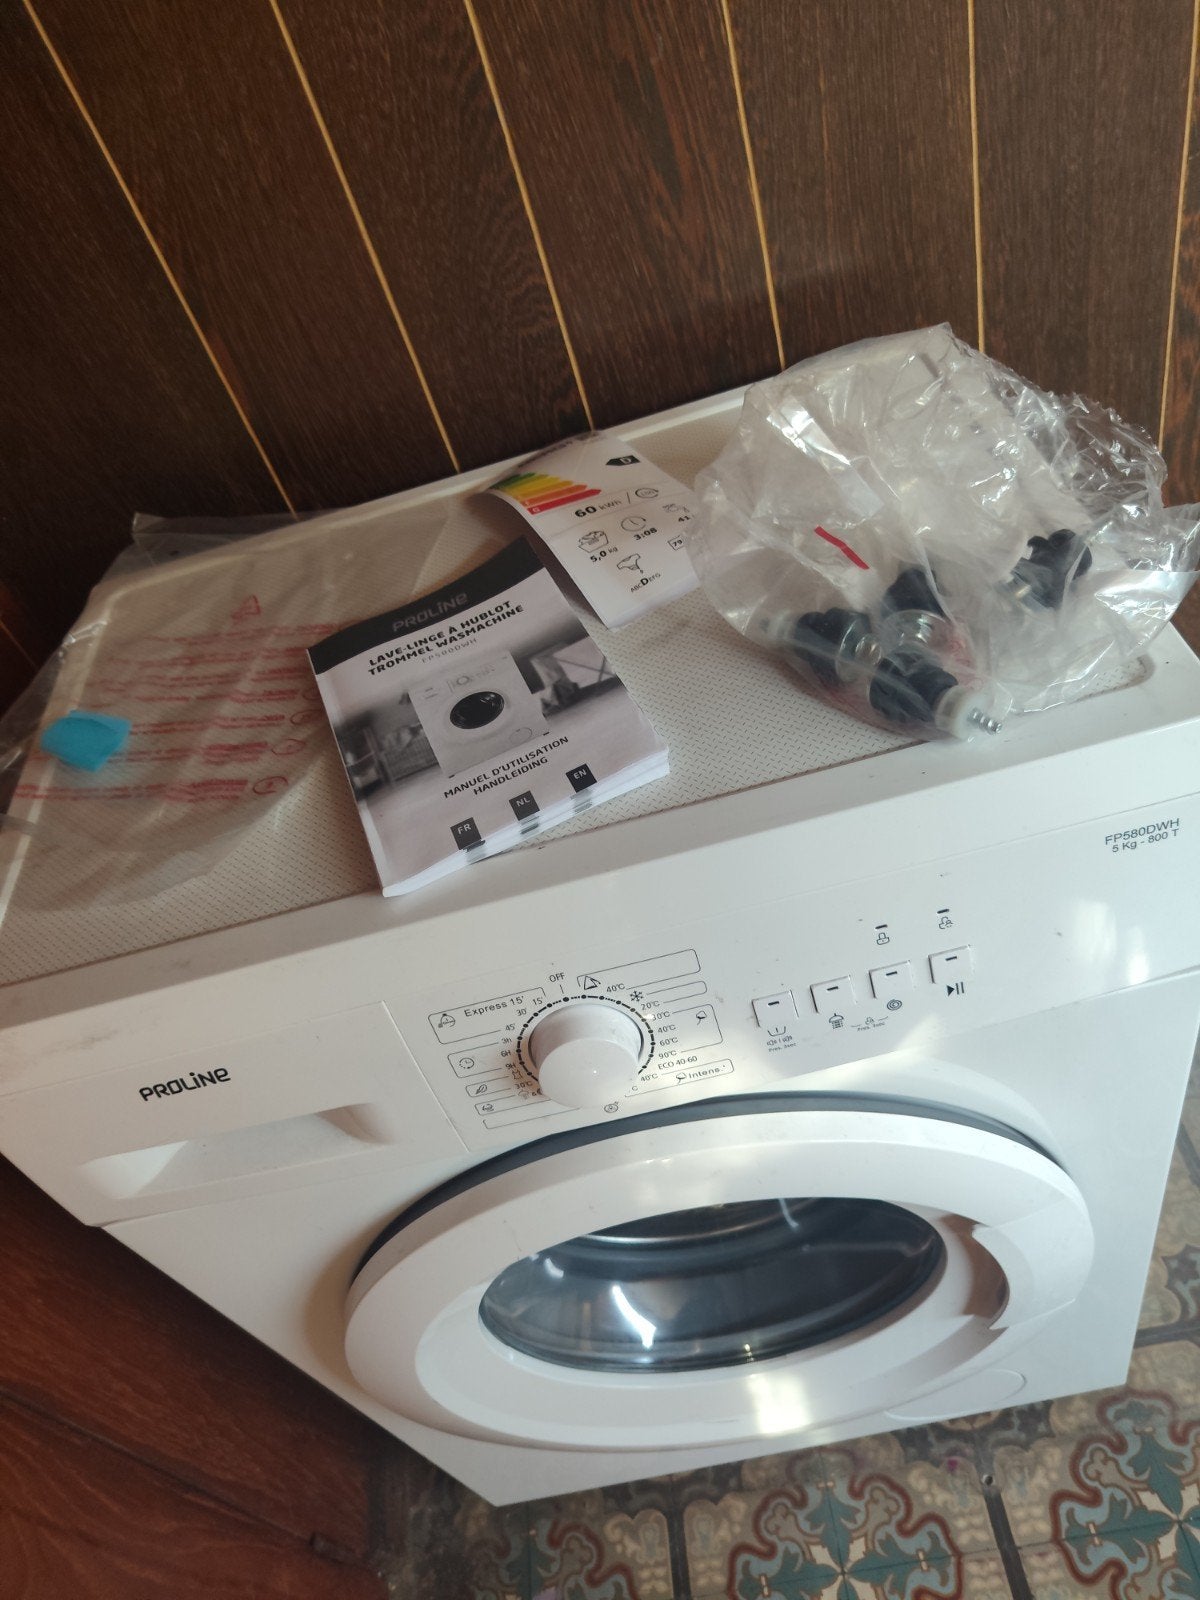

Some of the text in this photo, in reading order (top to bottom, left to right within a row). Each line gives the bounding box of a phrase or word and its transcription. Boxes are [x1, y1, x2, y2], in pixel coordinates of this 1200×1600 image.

[574, 505, 597, 518] 60
[599, 499, 622, 511] kWh
[633, 527, 658, 541] 3:08
[590, 546, 619, 563] 5,0 kg
[367, 604, 525, 676] TROMMEL WASMACHINE
[368, 630, 446, 667] LAVE-LINGE
[460, 600, 512, 629] HUBLOT
[443, 735, 570, 799] MANUEL D'UTILISATION
[572, 767, 588, 780] EN
[472, 756, 549, 796] HANDLEIDING
[515, 796, 531, 808] NL
[456, 823, 472, 835] FR
[1104, 817, 1180, 846] FP580DWH
[1111, 844, 1119, 853] 5
[1122, 840, 1137, 850] Kg
[1147, 831, 1169, 844] 800
[1171, 828, 1179, 837] T
[548, 972, 566, 983] OFF
[463, 1001, 508, 1018] Express
[657, 1060, 675, 1070] ECO
